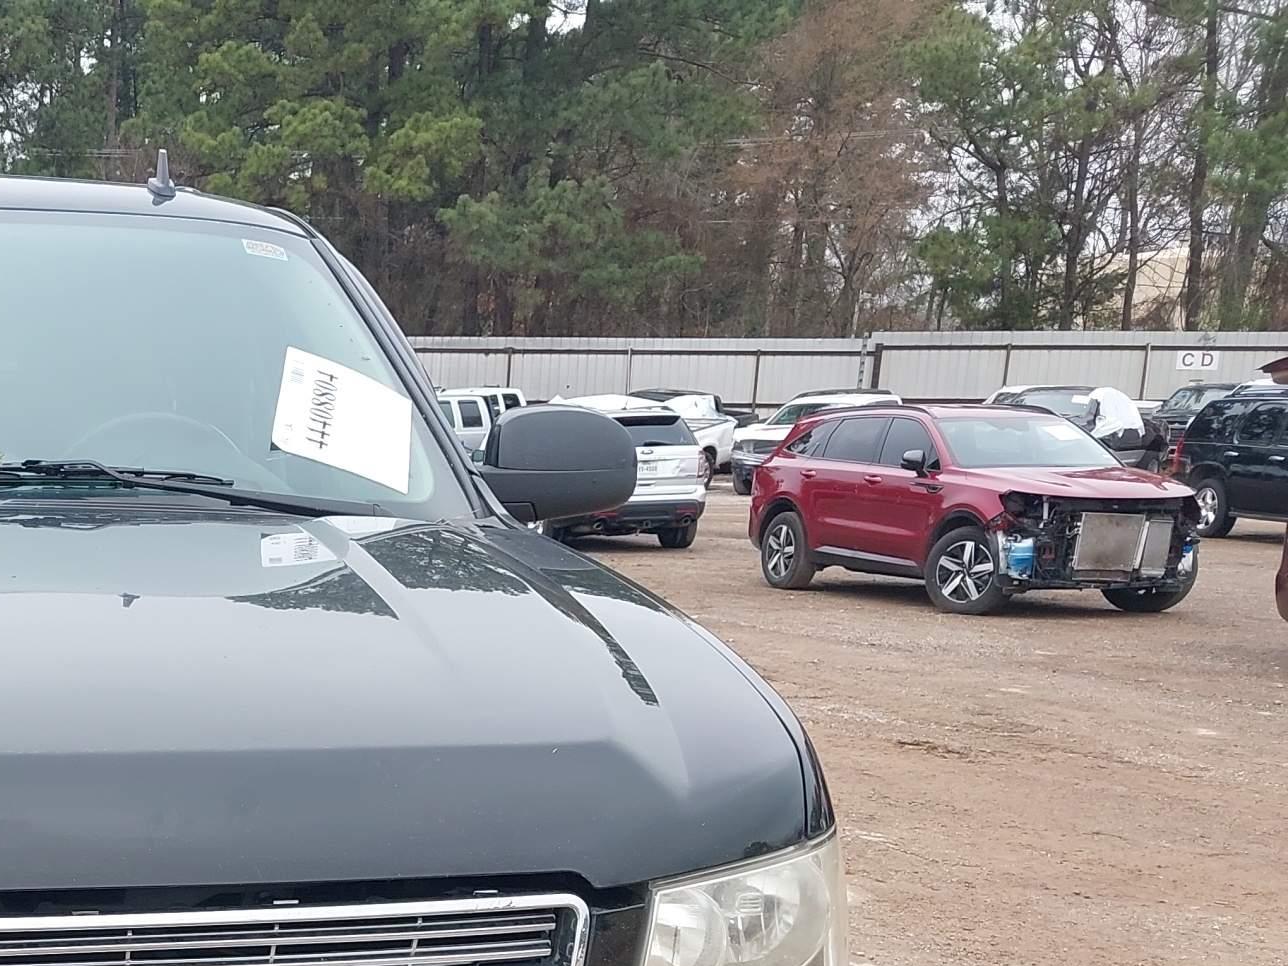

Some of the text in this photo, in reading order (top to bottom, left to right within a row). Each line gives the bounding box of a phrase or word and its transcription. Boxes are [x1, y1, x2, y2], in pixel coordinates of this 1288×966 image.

[1182, 352, 1214, 367] C D
[305, 369, 339, 450] 44408804
